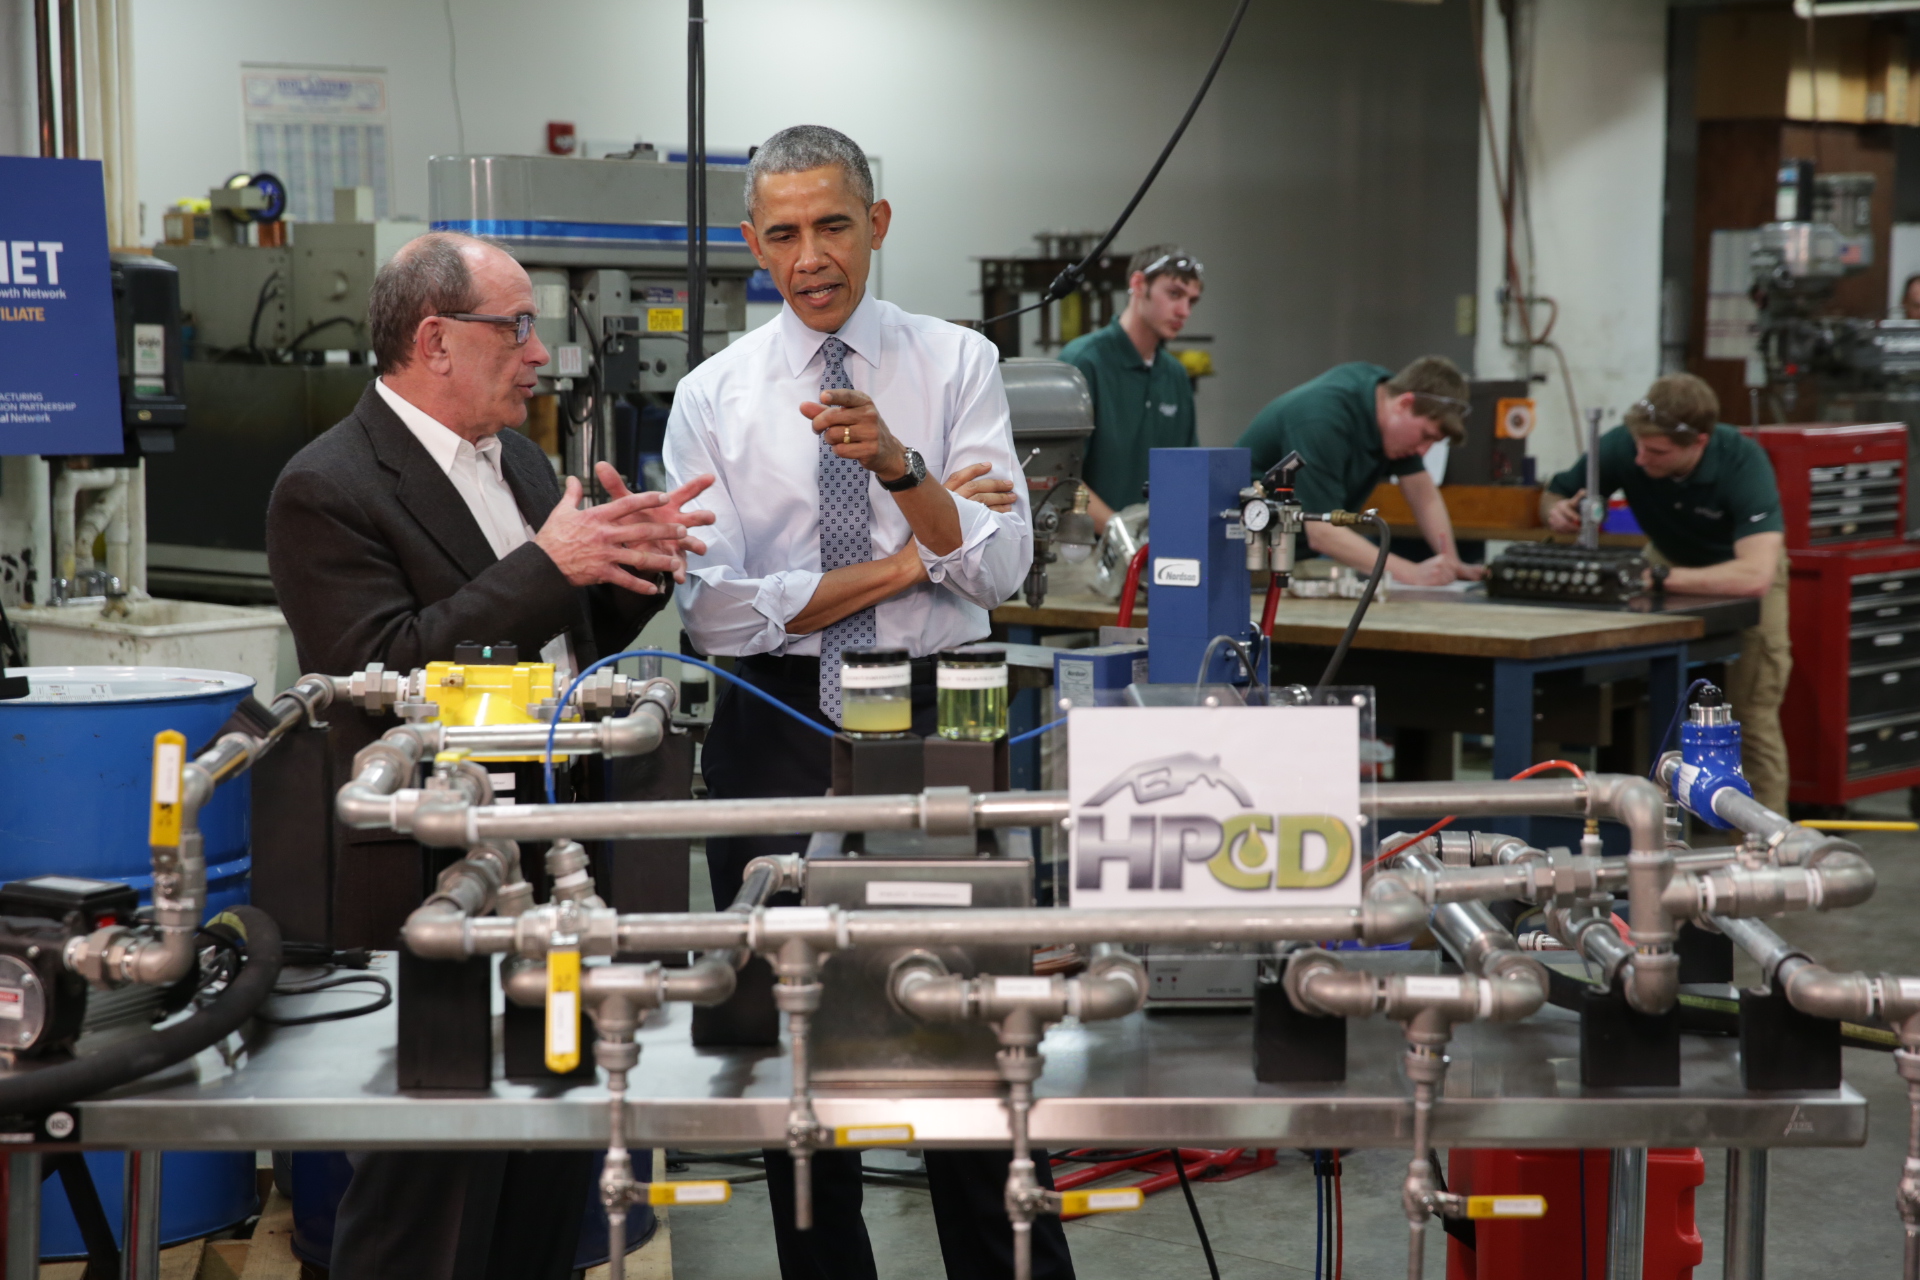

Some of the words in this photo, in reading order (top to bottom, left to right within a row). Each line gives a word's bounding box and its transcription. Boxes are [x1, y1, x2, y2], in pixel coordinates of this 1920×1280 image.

[23, 287, 67, 300] Network
[0, 306, 46, 322] ILIATE
[19, 401, 77, 412] PARTNERSHIP
[10, 412, 51, 424] Network
[1166, 571, 1196, 582] Nordson
[1076, 814, 1354, 891] HPCD
